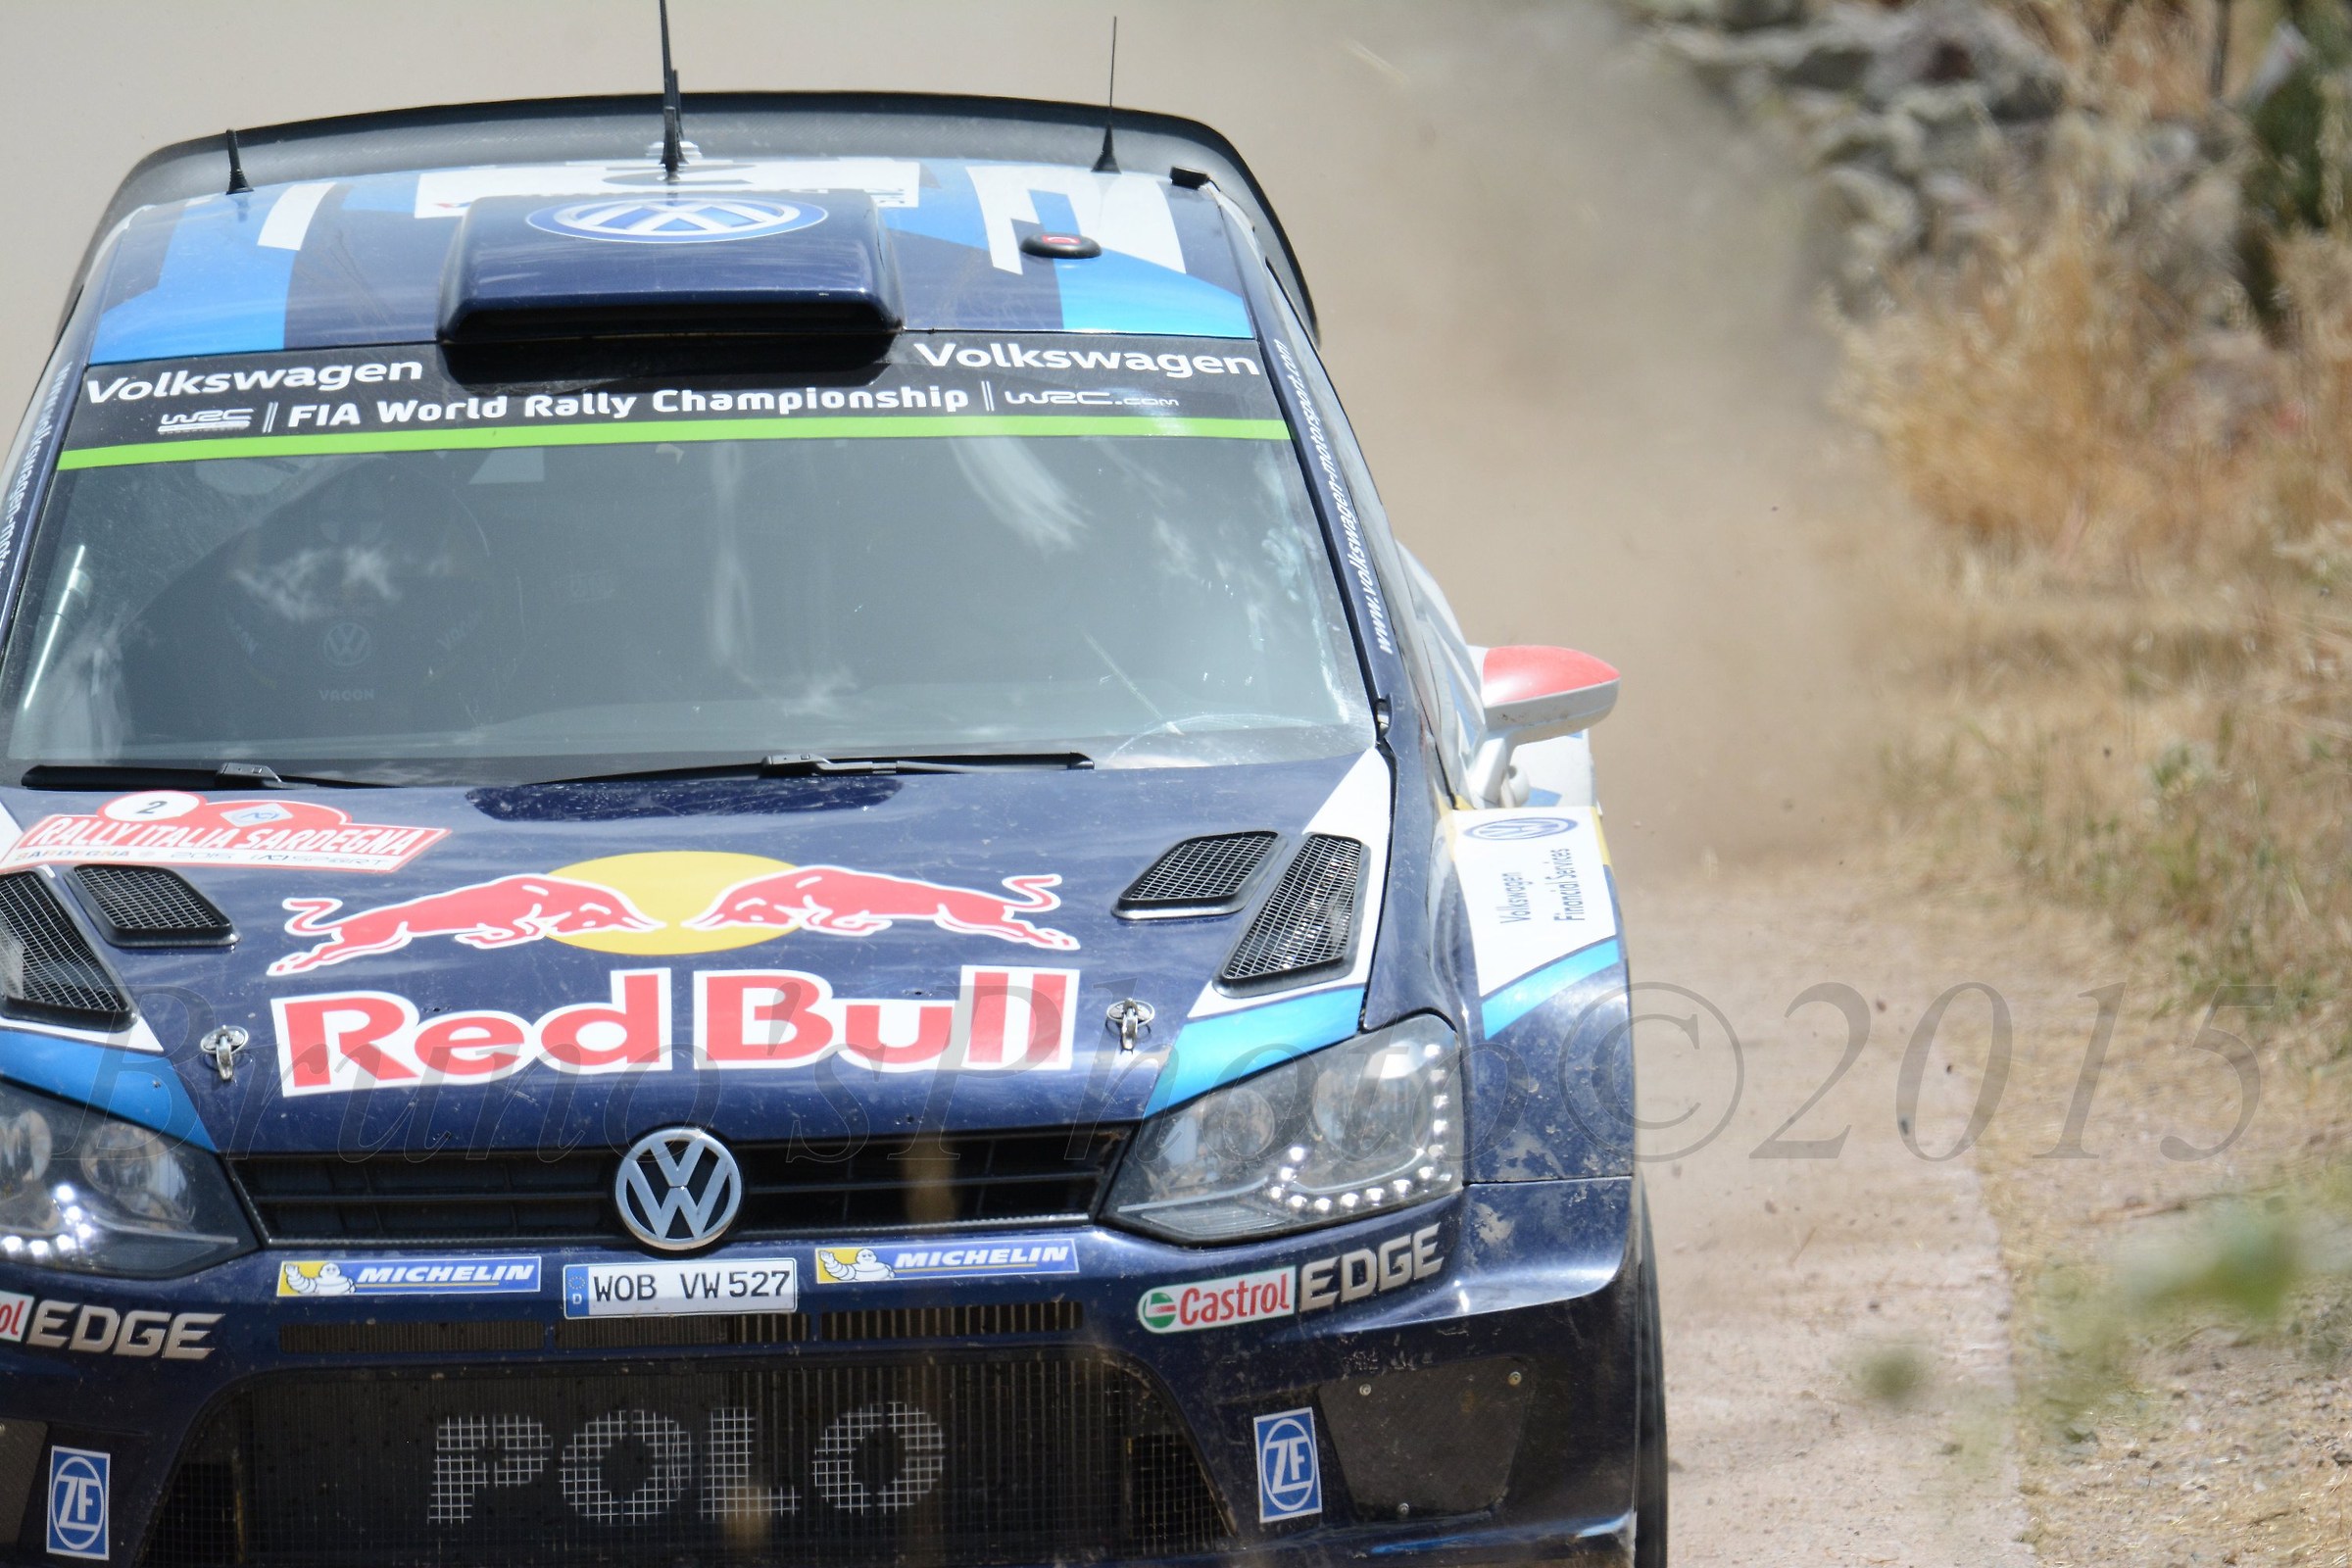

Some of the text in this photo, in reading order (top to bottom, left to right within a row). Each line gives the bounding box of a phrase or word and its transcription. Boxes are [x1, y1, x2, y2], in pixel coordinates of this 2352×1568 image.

[86, 361, 422, 404] Volkswagen
[913, 342, 1260, 378] Volkswagen
[287, 403, 362, 427] FIA
[376, 396, 508, 423] World
[524, 392, 636, 418] Rally
[654, 385, 969, 415] Championship
[1273, 338, 1394, 655] www.volkswagen-motorsport.com
[136, 801, 167, 814] 2
[29, 817, 426, 856] RALLY ITALIA SARDEGNA
[1494, 871, 1534, 924] Volkswagen
[1543, 848, 1586, 921] Financial Services
[270, 965, 1079, 1097] Red Bull
[357, 1263, 535, 1285] MICHELIN
[895, 1246, 1069, 1269] MICHELIN
[1177, 1223, 1444, 1326] Castrol EDGE
[572, 1293, 582, 1304] D
[594, 1274, 658, 1301] WOB
[26, 1299, 225, 1360] EDGE
[428, 1401, 947, 1525] POLO
[1265, 1435, 1314, 1495] ZF
[55, 1475, 102, 1530] ZF
